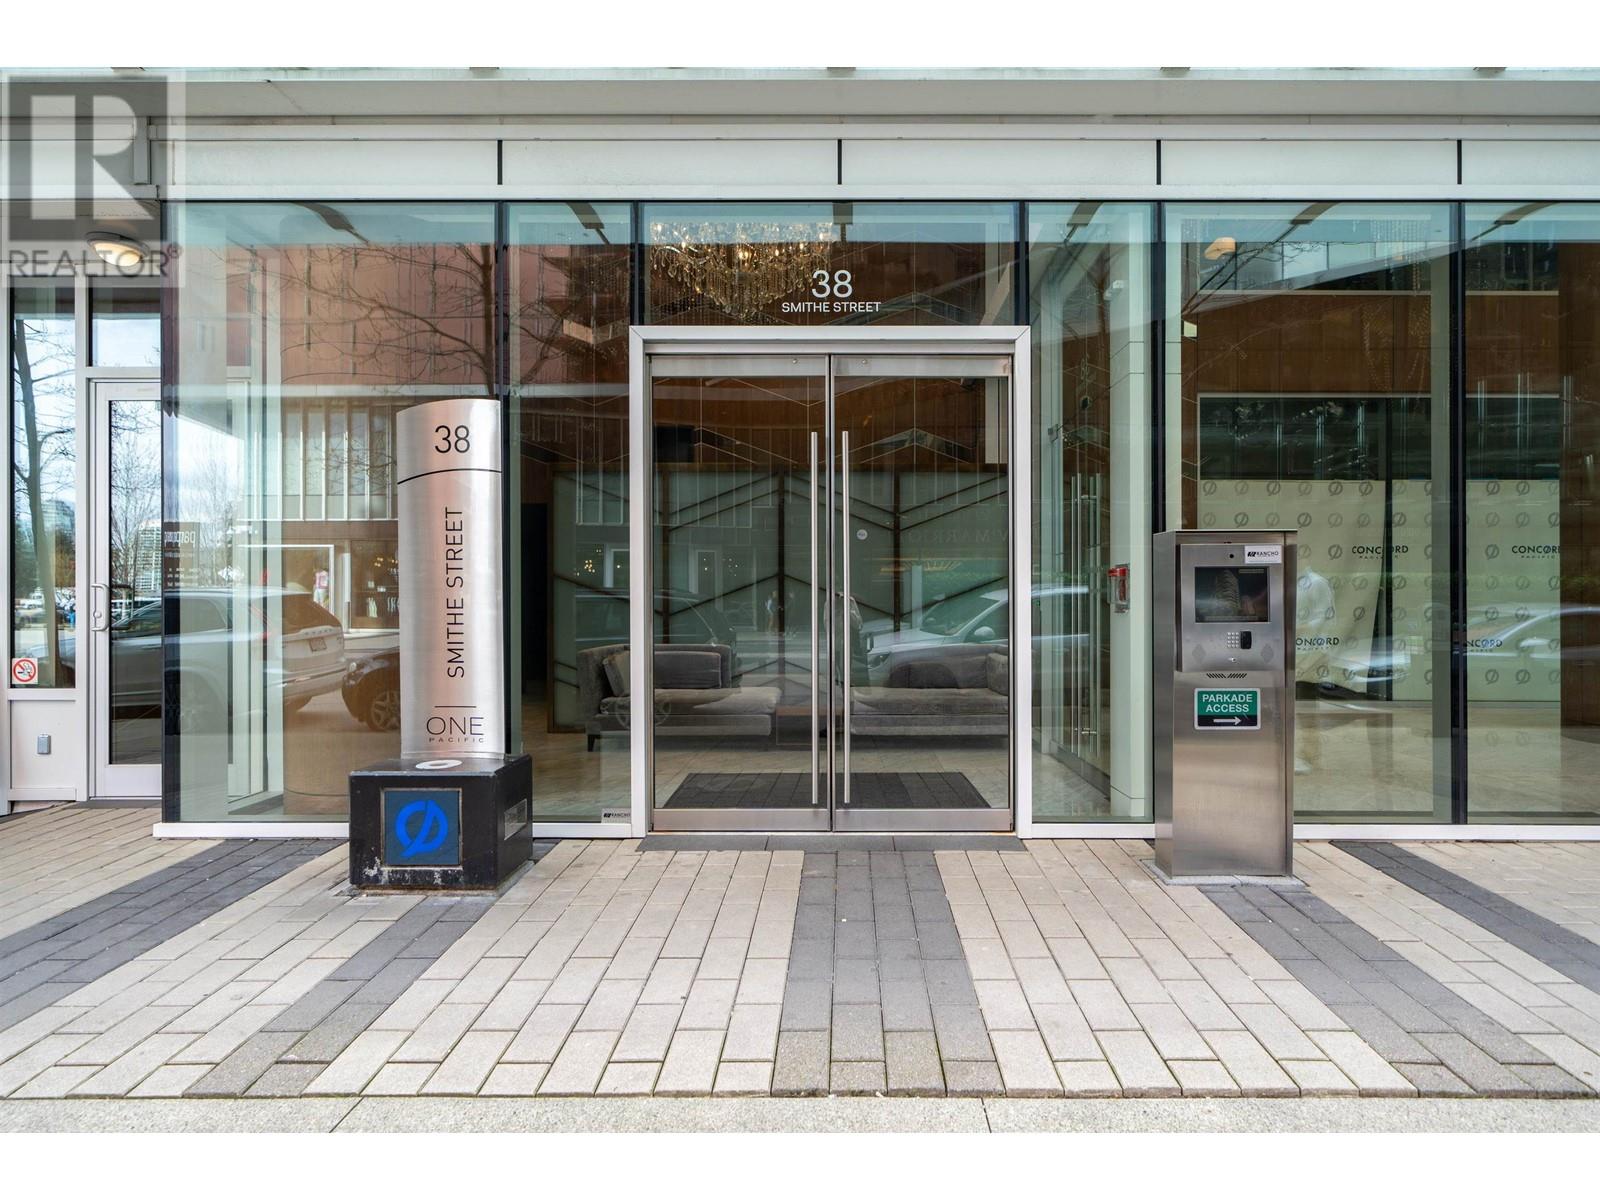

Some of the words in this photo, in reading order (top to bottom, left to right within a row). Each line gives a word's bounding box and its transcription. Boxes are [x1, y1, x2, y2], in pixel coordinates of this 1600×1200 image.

[811, 269, 853, 299] 38
[781, 301, 831, 313] SMITHE
[833, 301, 882, 313] STREET
[434, 424, 471, 454] 38
[444, 506, 464, 589] STREET
[1351, 545, 1409, 555] CONCRD
[446, 597, 465, 679] SMITHE
[1295, 637, 1340, 646] ONCORD
[1202, 694, 1253, 703] PARKADE
[1205, 704, 1250, 713] ACCESS
[426, 716, 485, 736] ONE
